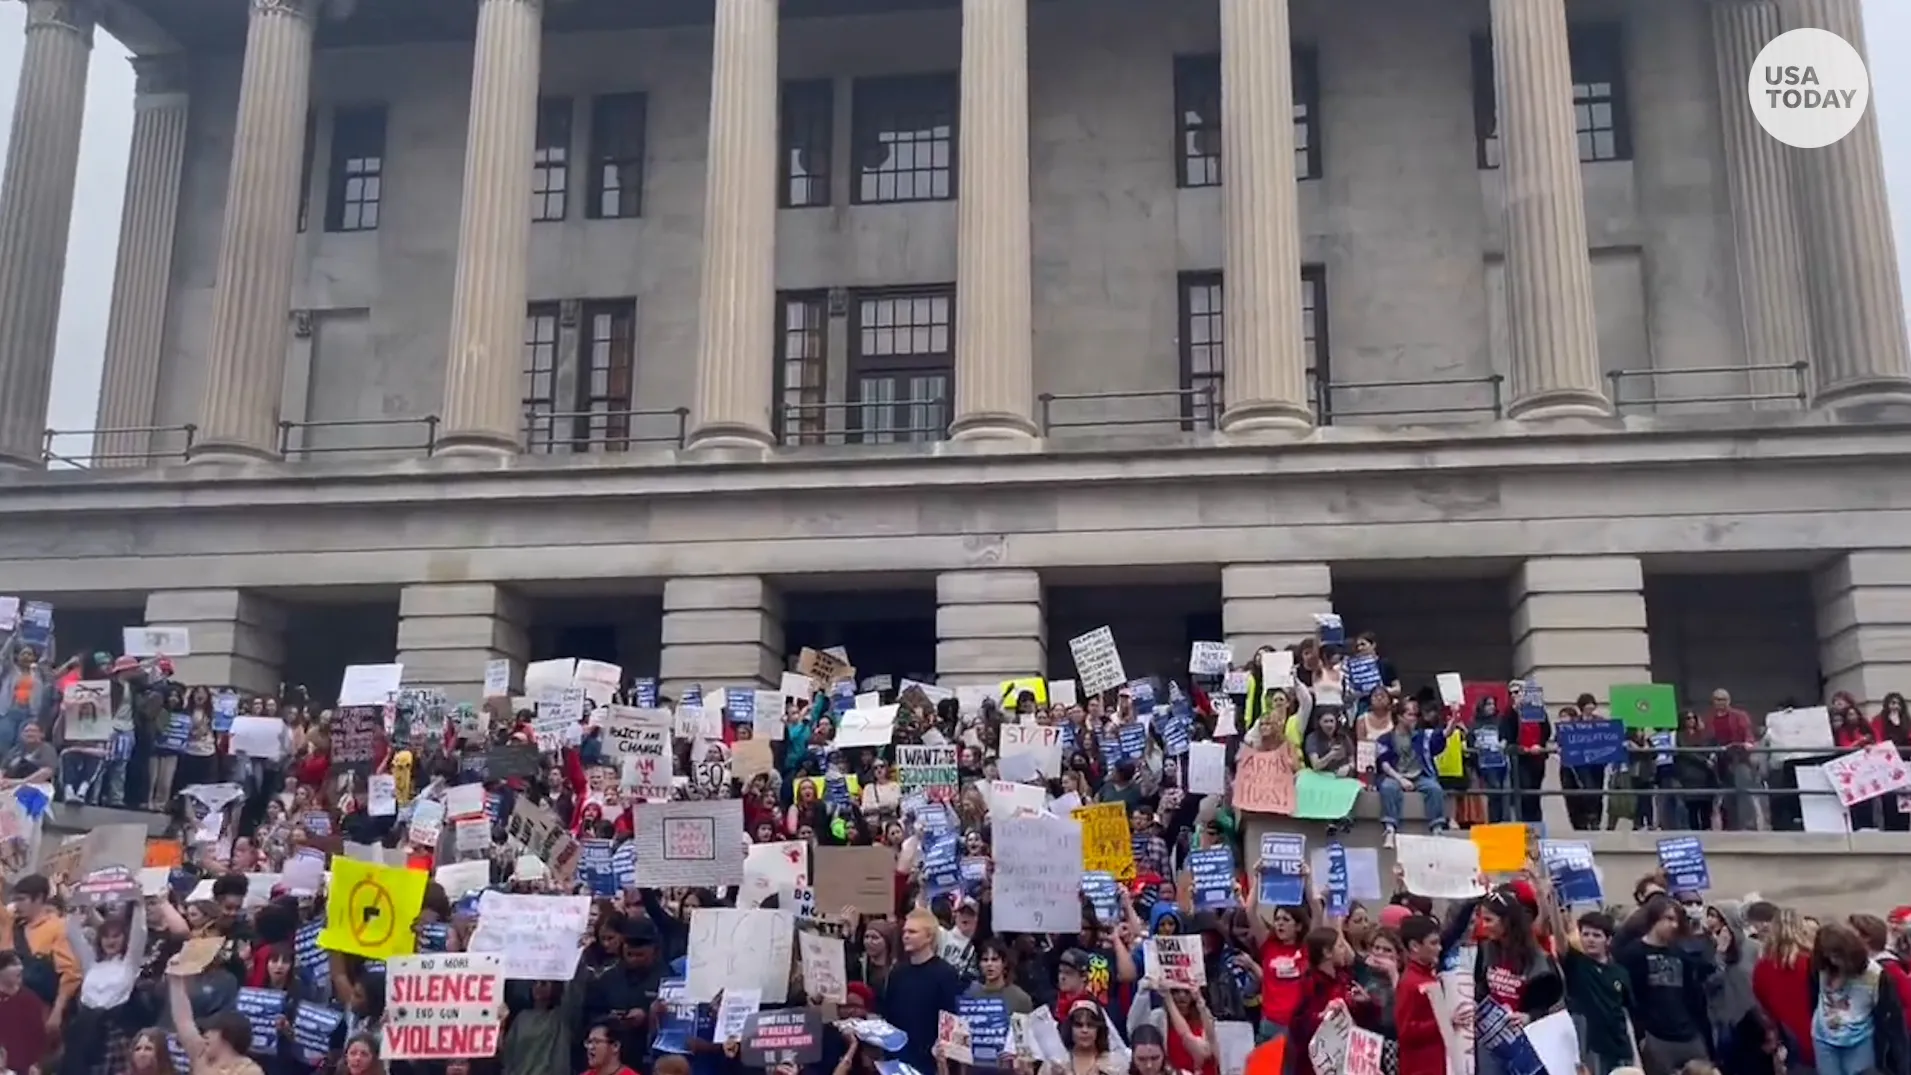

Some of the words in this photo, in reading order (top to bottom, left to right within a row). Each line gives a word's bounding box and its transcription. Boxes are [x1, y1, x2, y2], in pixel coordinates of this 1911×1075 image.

[904, 748, 941, 765] WANT
[1242, 755, 1287, 774] ARMS
[636, 759, 655, 771] AM
[1281, 861, 1300, 875] US
[421, 960, 436, 969] NO
[443, 958, 470, 969] MORE
[392, 974, 495, 1003] SILENCE
[416, 1008, 434, 1019] END
[440, 1008, 460, 1019] GUN
[677, 1005, 695, 1021] US
[386, 1024, 498, 1055] VIOLENCE
